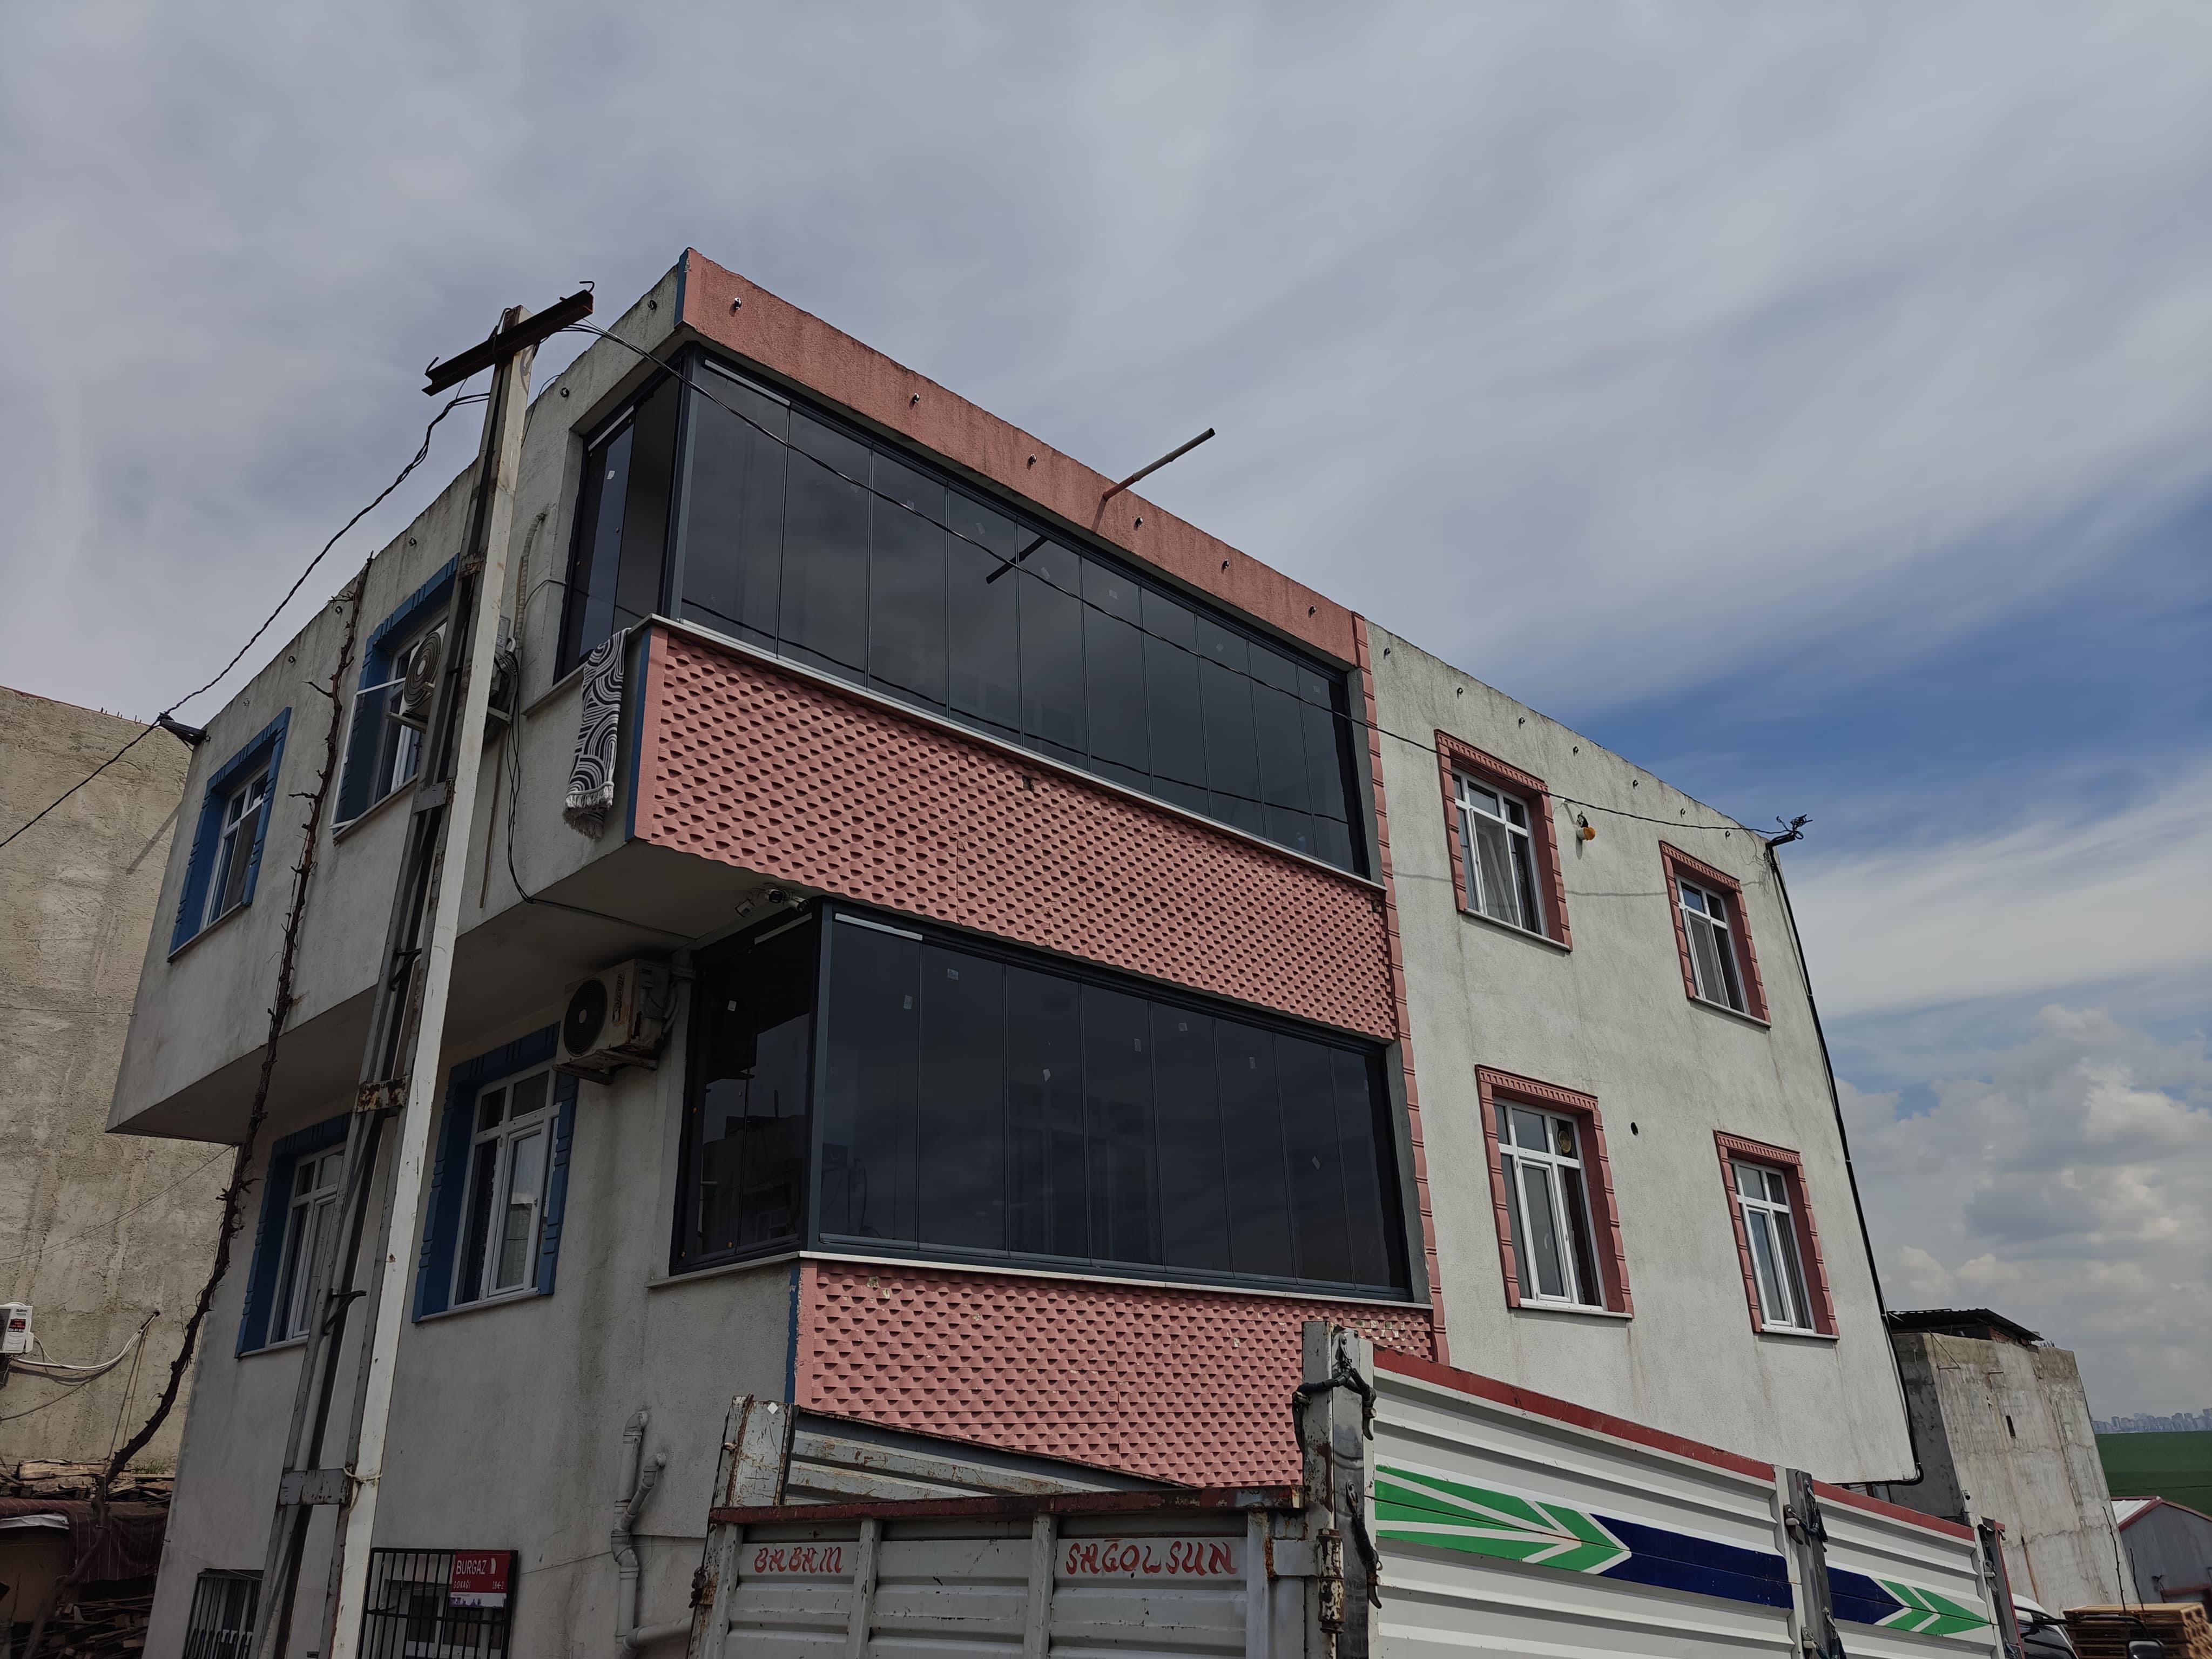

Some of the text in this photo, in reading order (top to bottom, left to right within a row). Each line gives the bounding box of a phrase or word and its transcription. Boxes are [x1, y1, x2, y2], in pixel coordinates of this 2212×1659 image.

[456, 1559, 487, 1575] BURGAZ
[754, 1546, 844, 1574] BABAM
[453, 1580, 471, 1589] SOKAĞI
